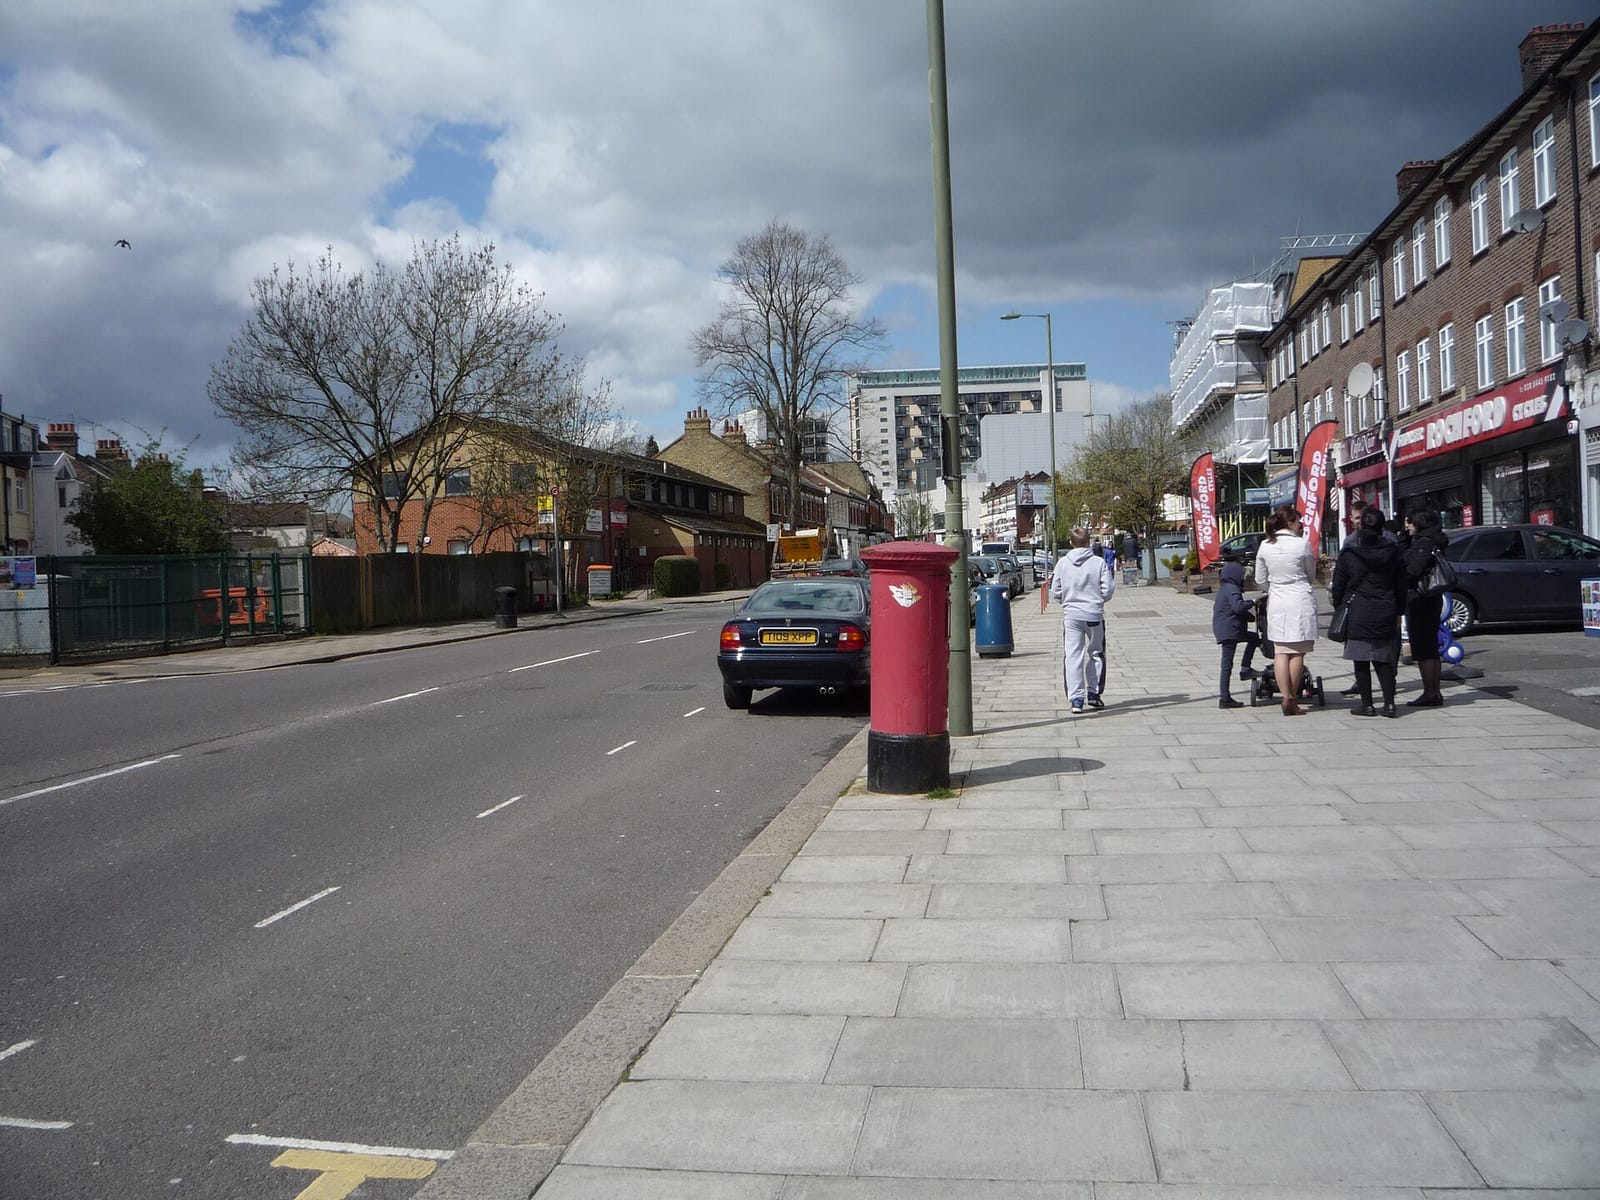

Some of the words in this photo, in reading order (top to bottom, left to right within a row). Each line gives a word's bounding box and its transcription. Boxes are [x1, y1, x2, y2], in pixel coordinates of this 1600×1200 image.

[1198, 475, 1213, 544] ROCHFORD
[1302, 450, 1322, 541] OCHFORD
[767, 632, 789, 641] T109
[791, 632, 812, 641] XPP
